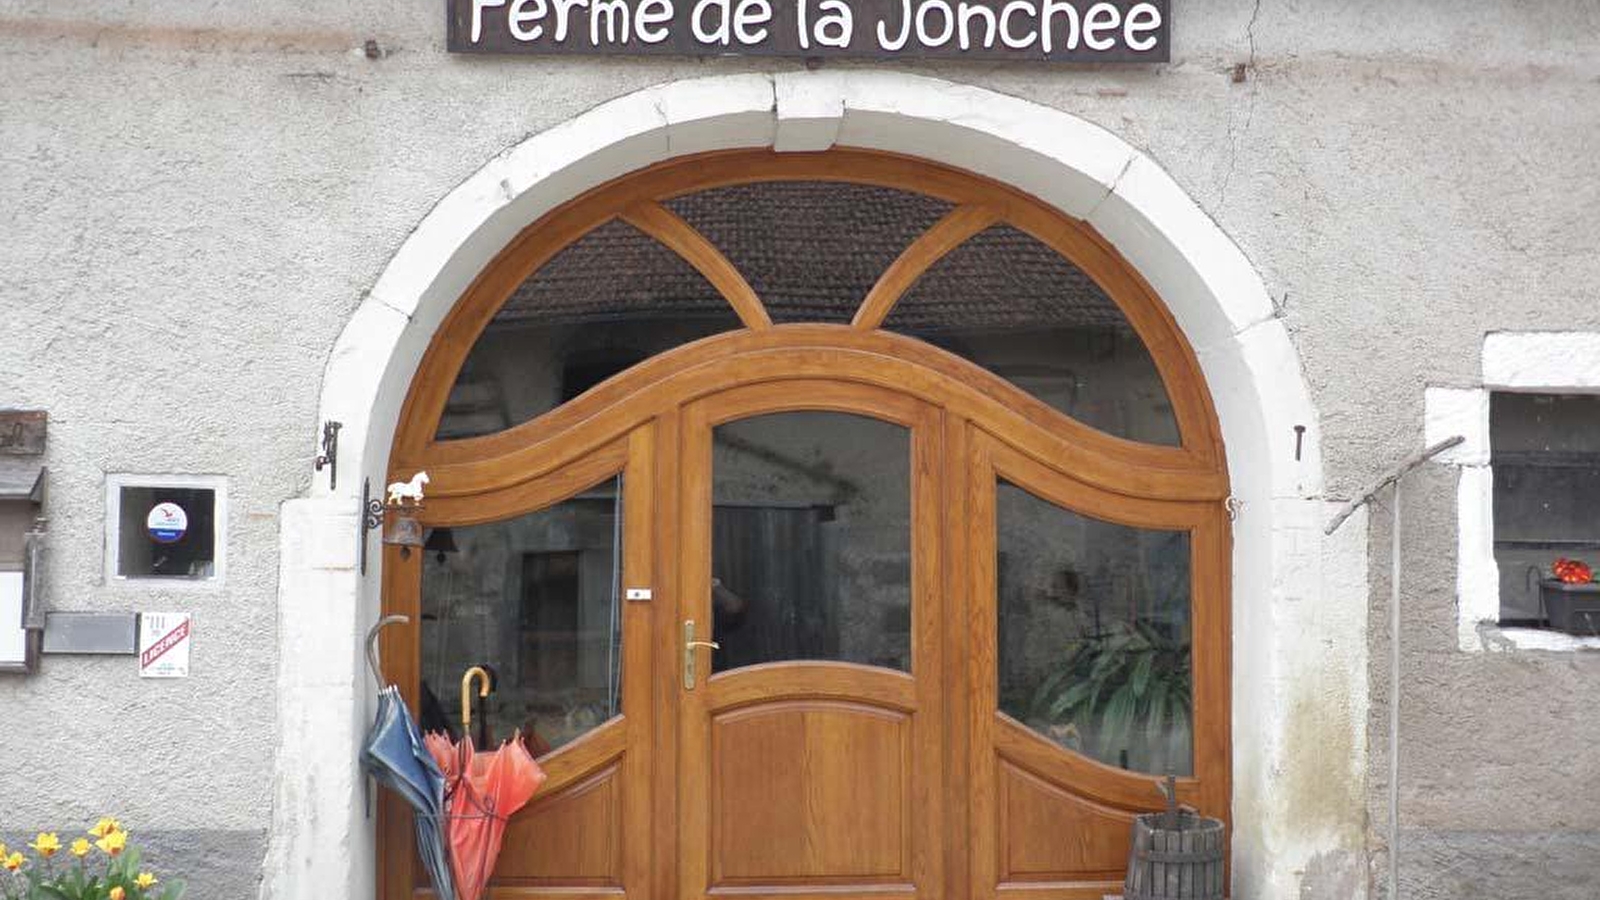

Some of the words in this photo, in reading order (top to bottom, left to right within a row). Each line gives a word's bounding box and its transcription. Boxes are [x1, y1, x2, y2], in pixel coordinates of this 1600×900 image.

[471, 0, 675, 46] Ferme
[691, 0, 773, 46] de
[797, 0, 853, 50] la
[143, 624, 187, 666] LICENCE
